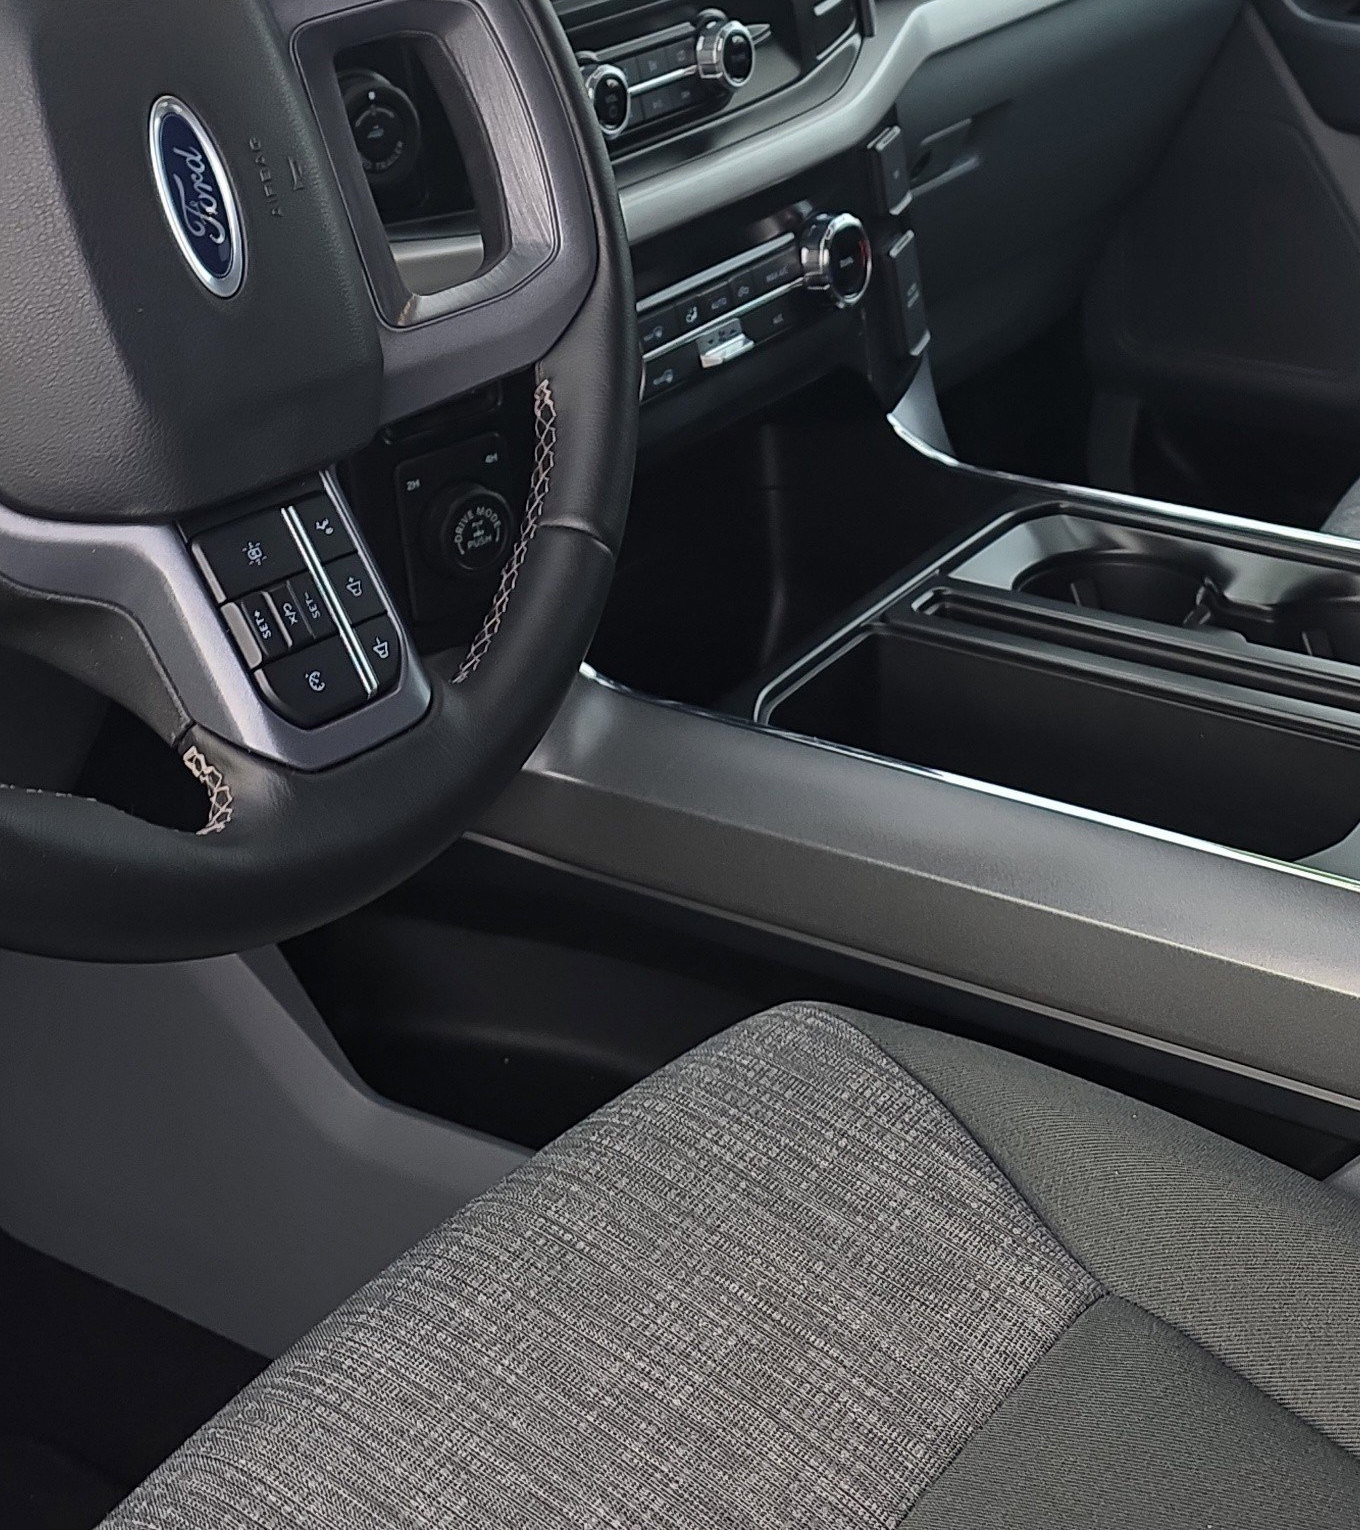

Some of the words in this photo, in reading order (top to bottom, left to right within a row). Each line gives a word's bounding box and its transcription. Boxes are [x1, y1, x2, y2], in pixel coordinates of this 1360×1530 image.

[172, 146, 226, 245] Ford
[249, 136, 284, 218] AIRBAG
[454, 509, 474, 543] DRIVE
[476, 506, 501, 529] MODE
[467, 534, 493, 549] PUSH
